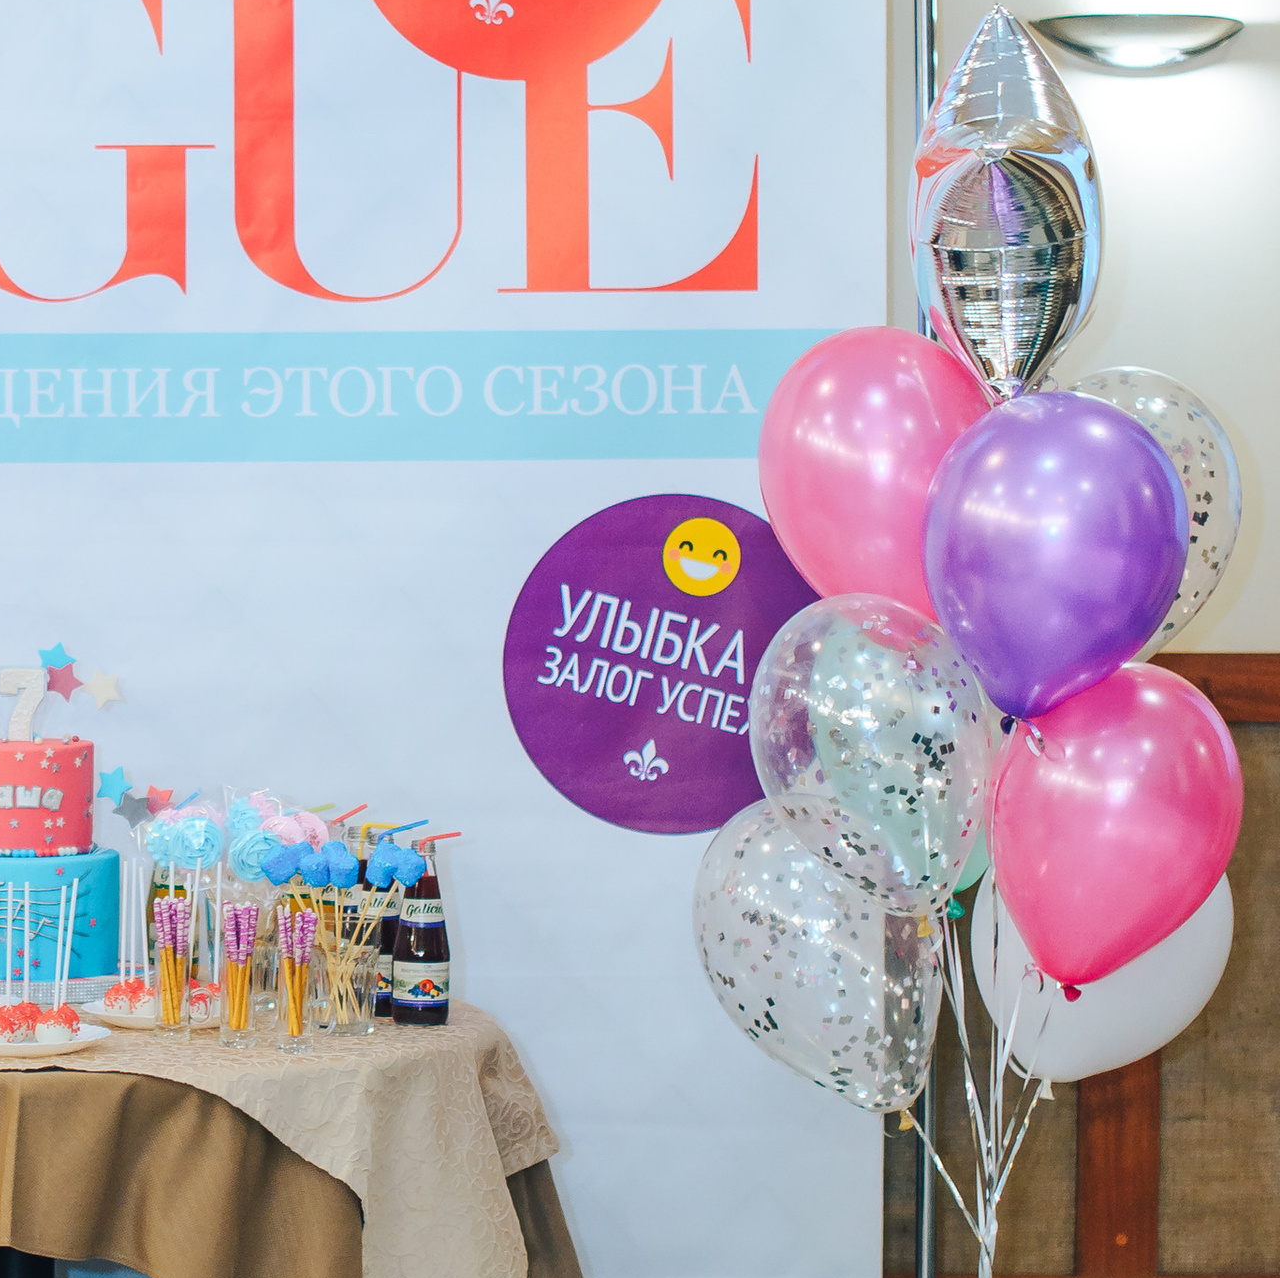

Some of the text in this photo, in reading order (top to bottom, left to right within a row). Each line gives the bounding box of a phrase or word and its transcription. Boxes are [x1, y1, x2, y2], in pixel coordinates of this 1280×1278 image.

[241, 365, 463, 418] ЭТОГО
[483, 363, 758, 416] СЕЗОНА
[553, 582, 745, 685] УЛЫБКА
[0, 665, 47, 742] 7
[536, 644, 655, 707] ЗАЛОГ
